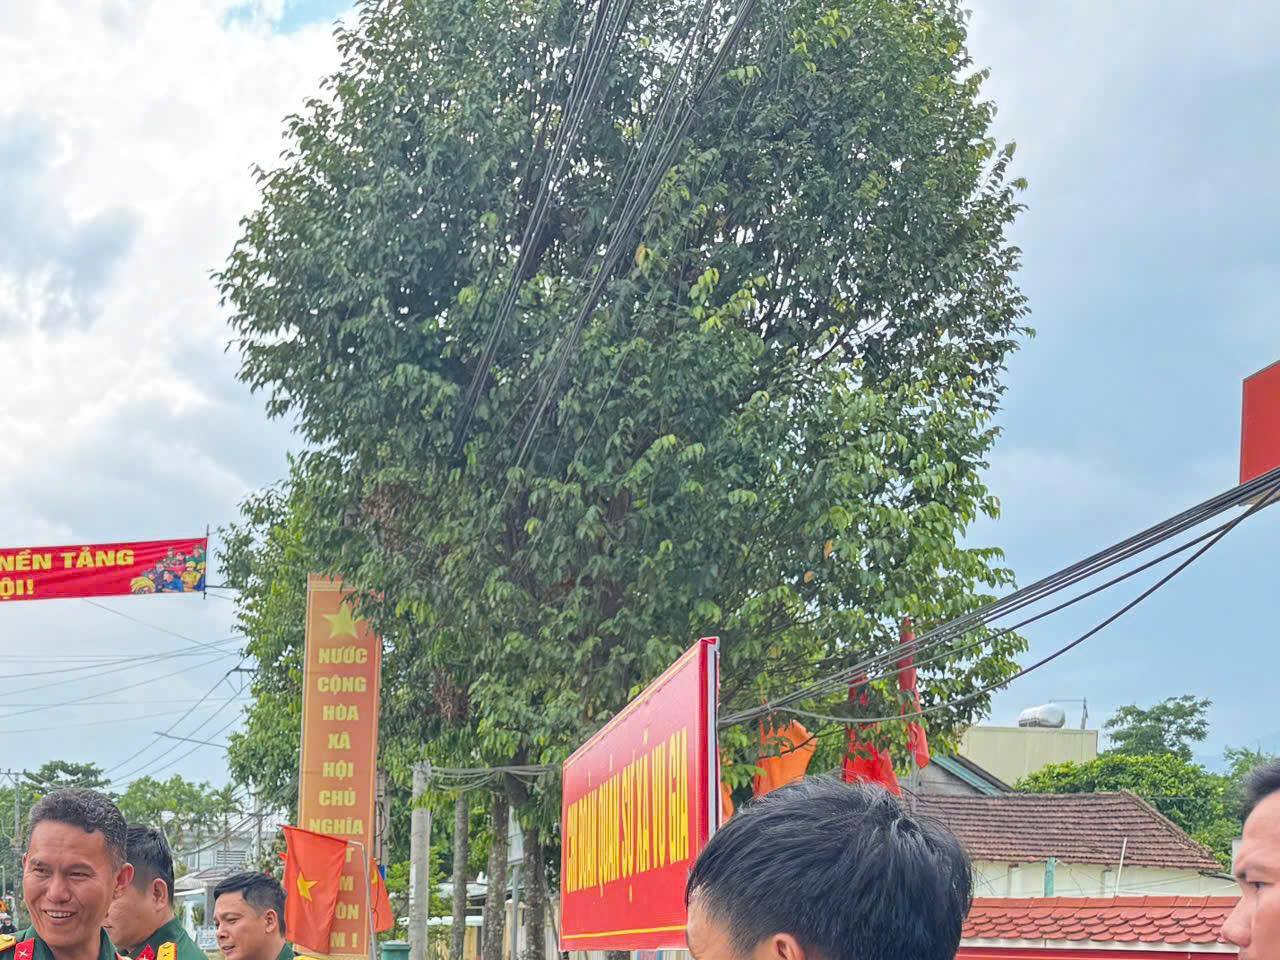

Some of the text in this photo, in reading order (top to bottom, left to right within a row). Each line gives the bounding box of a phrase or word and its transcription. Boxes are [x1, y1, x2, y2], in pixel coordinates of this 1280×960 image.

[61, 546, 135, 569] TẢNG
[318, 644, 368, 664] NƯỚC
[317, 673, 367, 696] CỘNG
[322, 703, 360, 721] HÒA
[327, 731, 352, 750] XÃ
[322, 758, 355, 781] HỘI
[318, 787, 357, 807] CHỦ
[651, 740, 666, 869] VU
[669, 726, 689, 865] GIA
[309, 815, 364, 834] NGHĨA
[336, 902, 360, 921] ÔN
